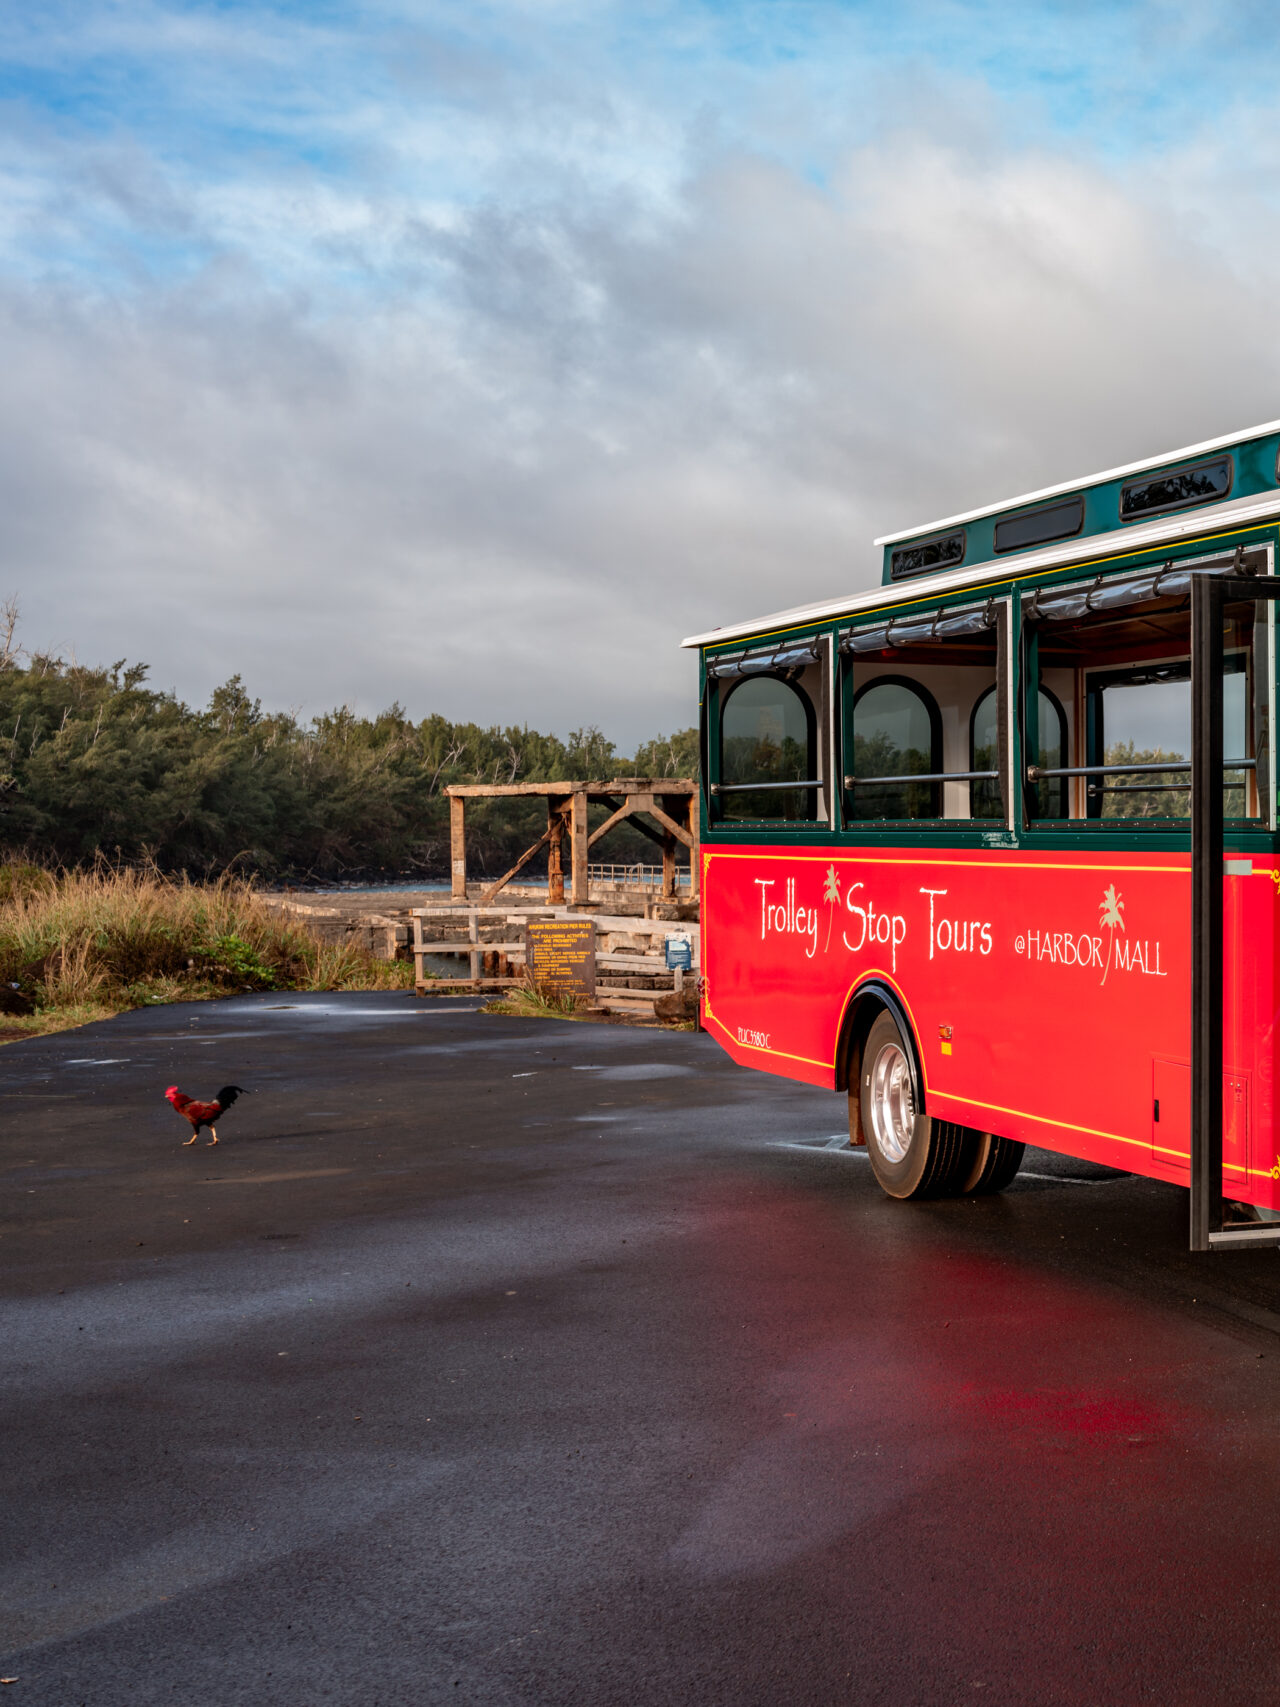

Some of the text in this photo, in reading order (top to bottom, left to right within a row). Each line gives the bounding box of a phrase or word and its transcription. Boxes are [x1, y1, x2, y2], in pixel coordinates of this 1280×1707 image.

[754, 877, 993, 974] Trolley Stop Tours
[1115, 938, 1168, 976] MALL
